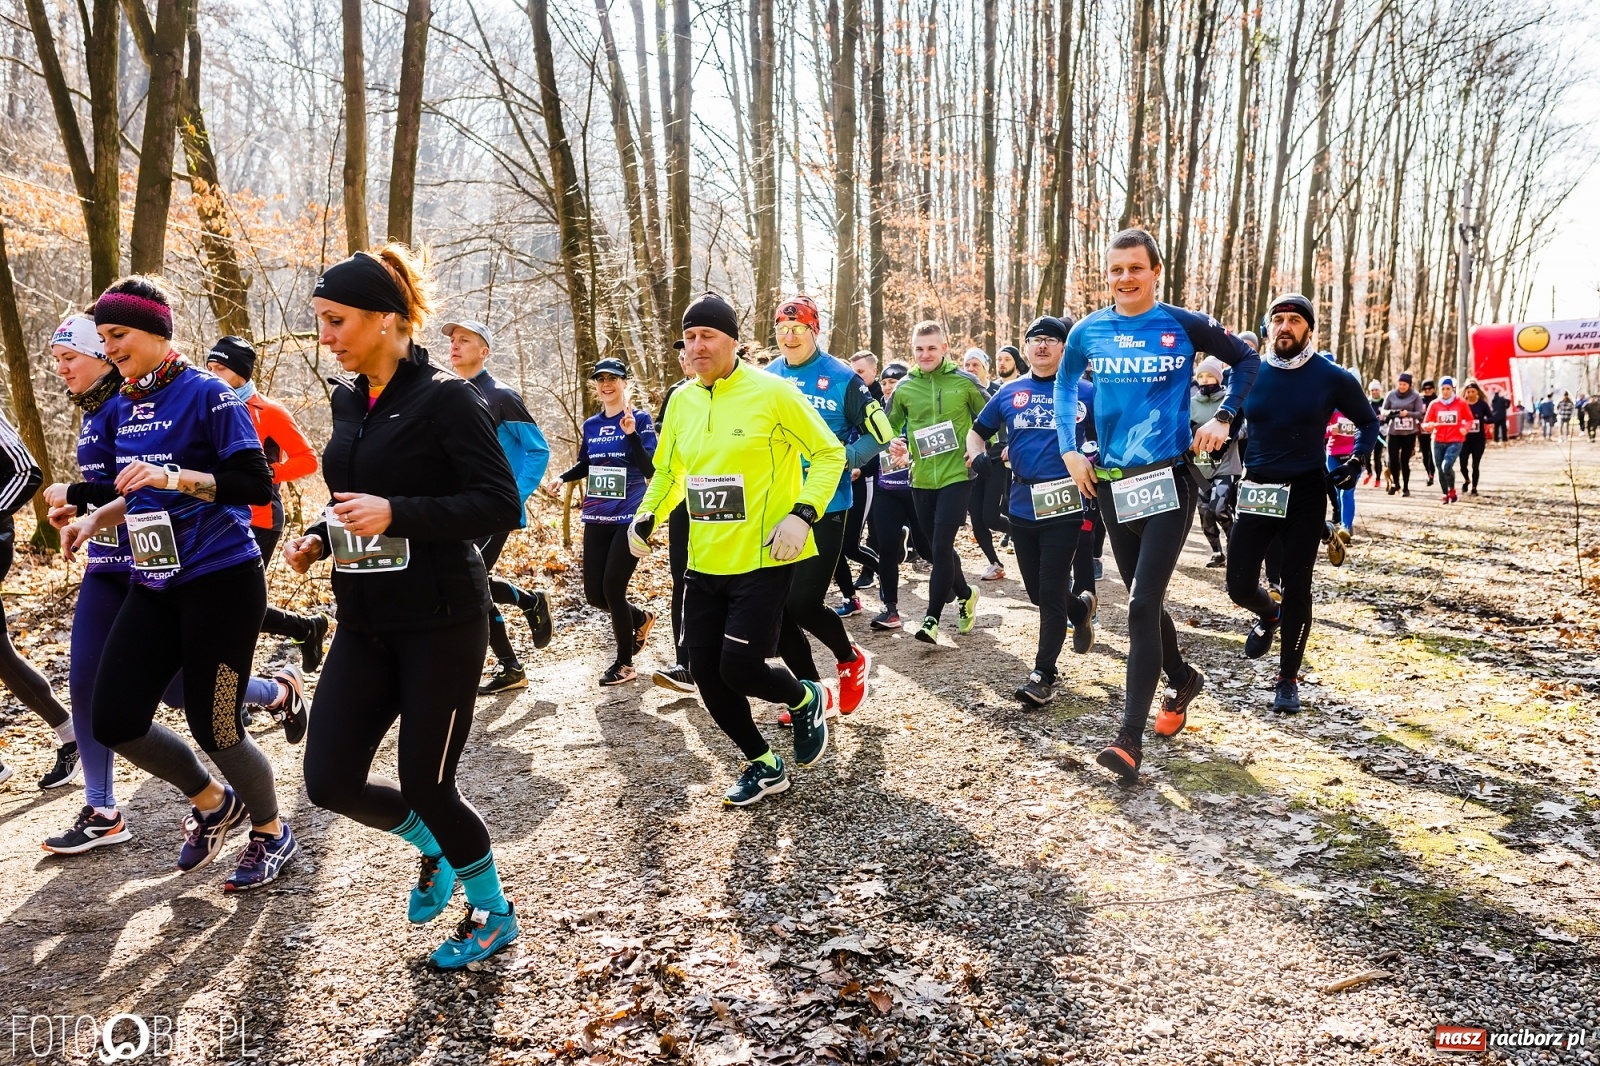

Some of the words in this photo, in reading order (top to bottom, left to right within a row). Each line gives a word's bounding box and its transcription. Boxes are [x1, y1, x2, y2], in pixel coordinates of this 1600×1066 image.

[1558, 331, 1600, 341] TWARD
[1141, 375, 1167, 383] TEAM
[116, 420, 173, 437] FEROCITY
[924, 432, 947, 449] 133
[141, 452, 173, 462] TEAM
[595, 476, 616, 489] 015
[698, 491, 727, 509] 127
[1044, 489, 1071, 507] 016
[1126, 484, 1165, 507] 094
[1247, 489, 1278, 506] 034
[133, 531, 162, 553] 100
